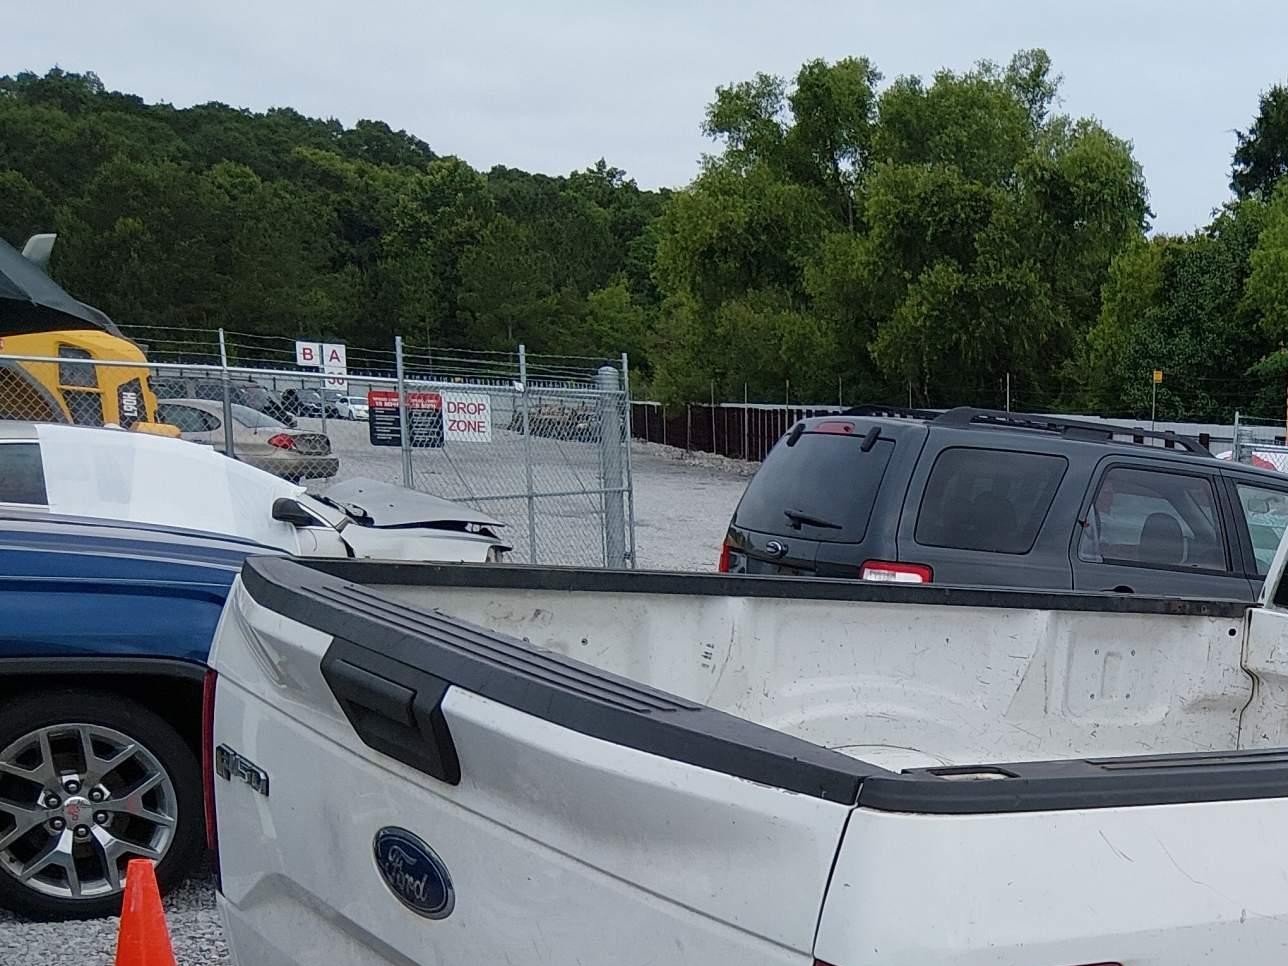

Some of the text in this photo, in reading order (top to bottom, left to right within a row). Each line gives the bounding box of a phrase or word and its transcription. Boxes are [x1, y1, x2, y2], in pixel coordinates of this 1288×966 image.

[303, 348, 314, 361] B
[329, 350, 341, 362] A
[447, 401, 486, 415] DROP
[448, 419, 486, 433] ZONE
[385, 845, 428, 902] Ford
